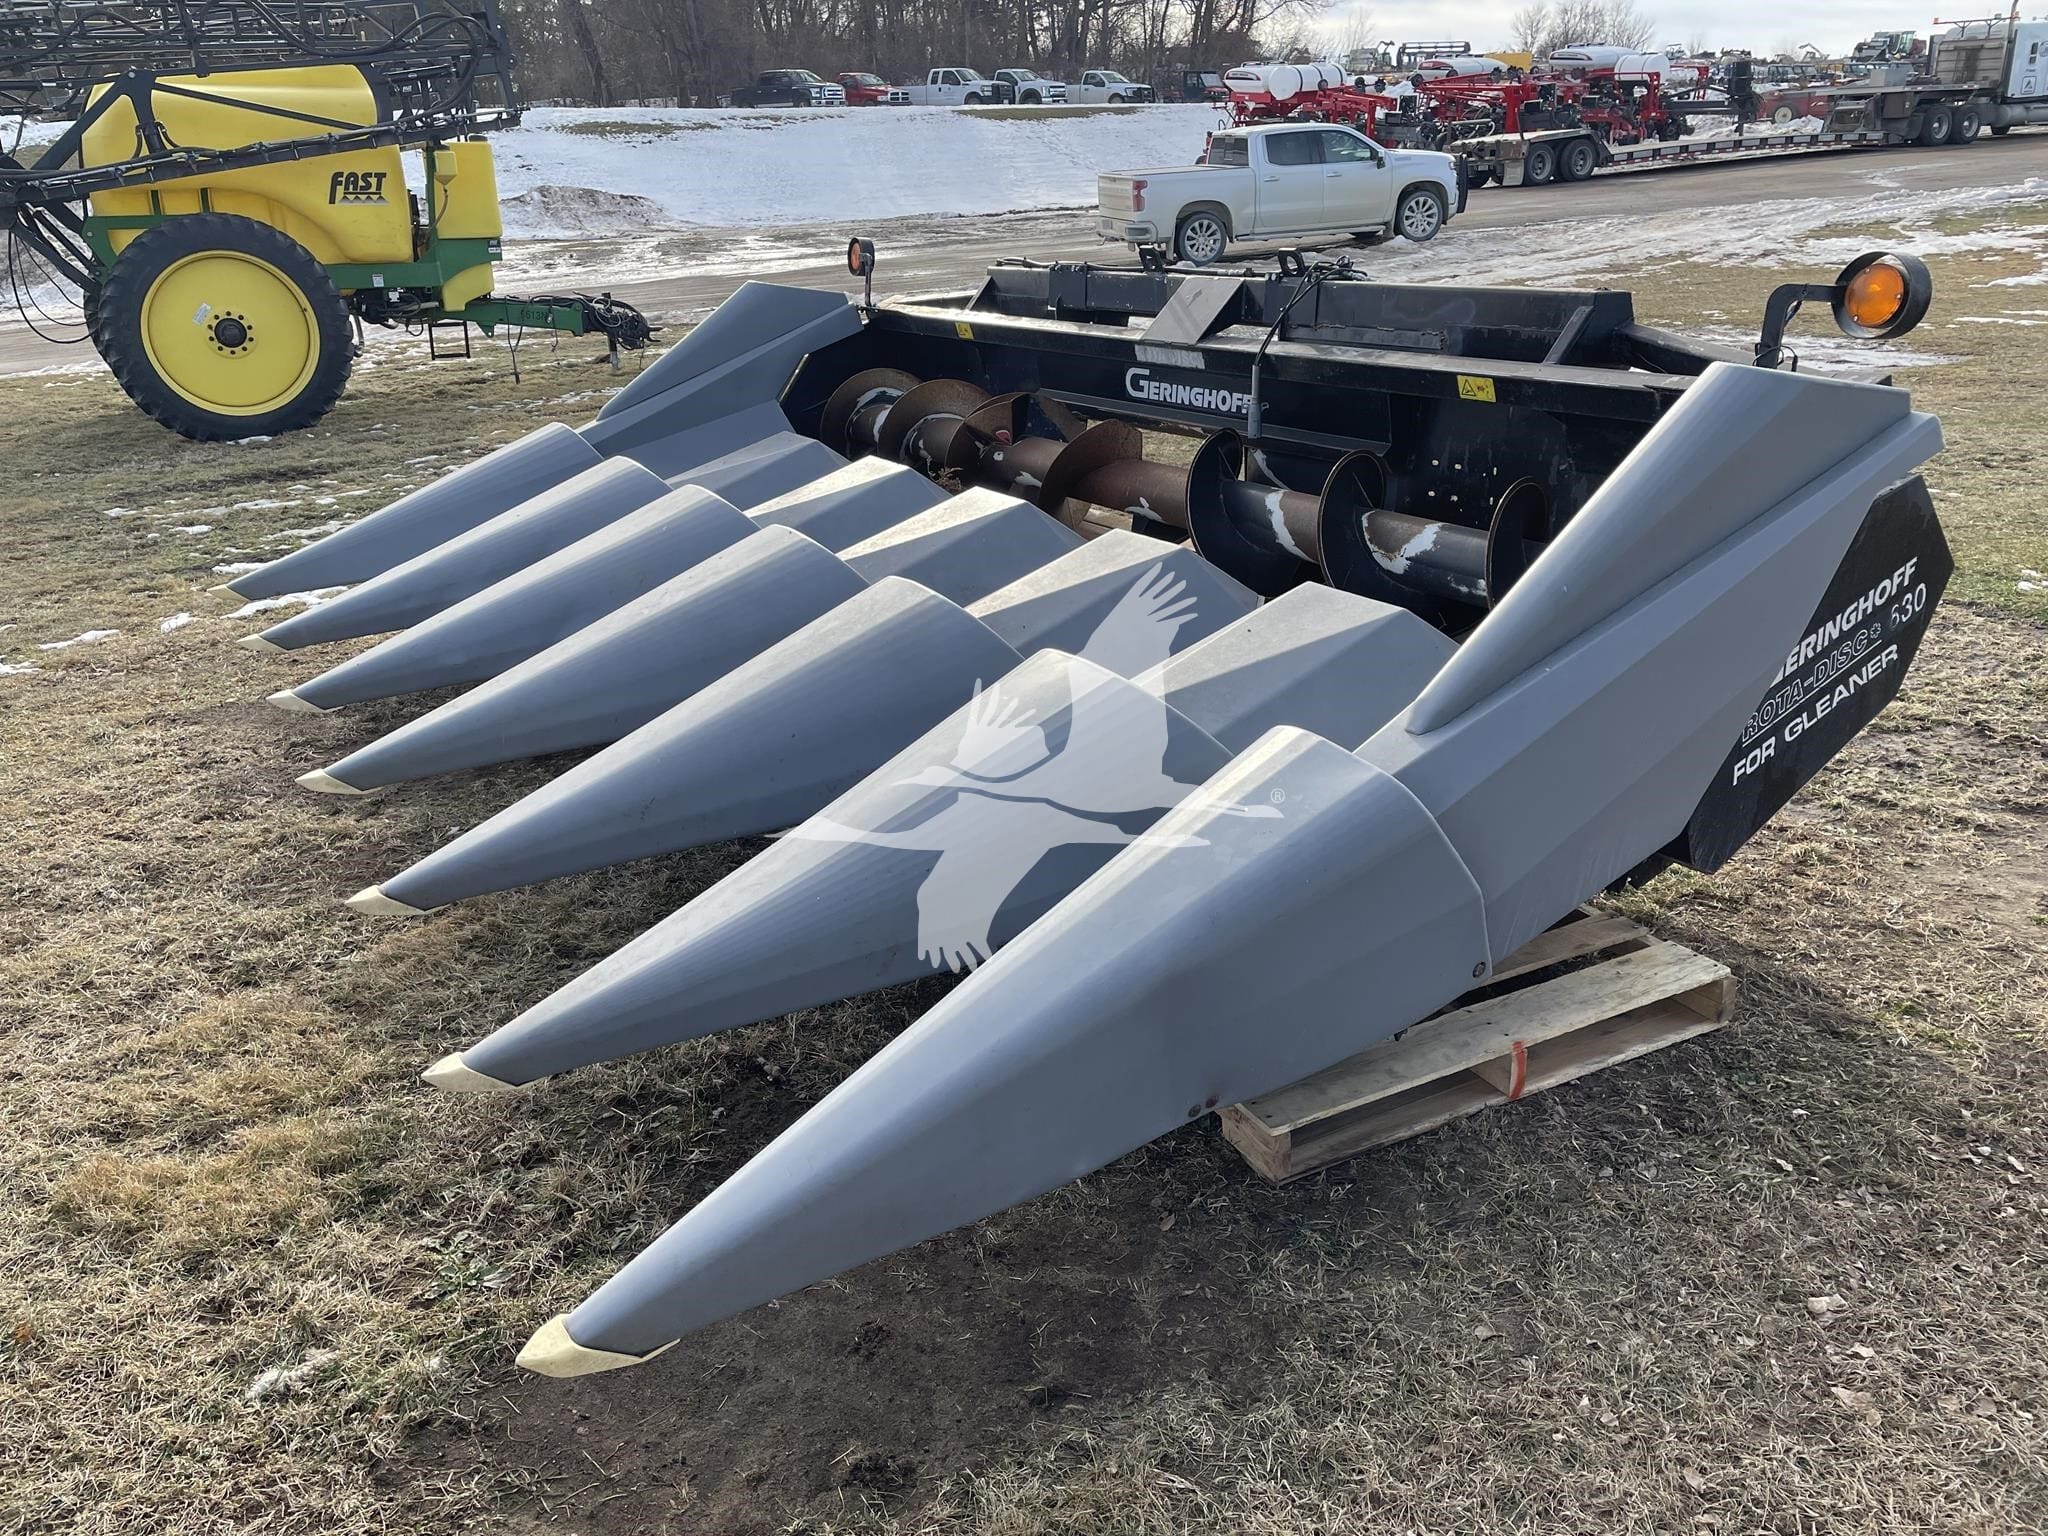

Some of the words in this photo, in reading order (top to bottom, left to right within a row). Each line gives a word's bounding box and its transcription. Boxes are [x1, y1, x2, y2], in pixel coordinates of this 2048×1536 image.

[328, 171, 387, 205] FAST
[1770, 557, 1918, 688] ERINGHOFF
[1890, 582, 1927, 631] 630
[1733, 736, 1776, 786] FOR
[1784, 644, 1898, 742] GLEANER
